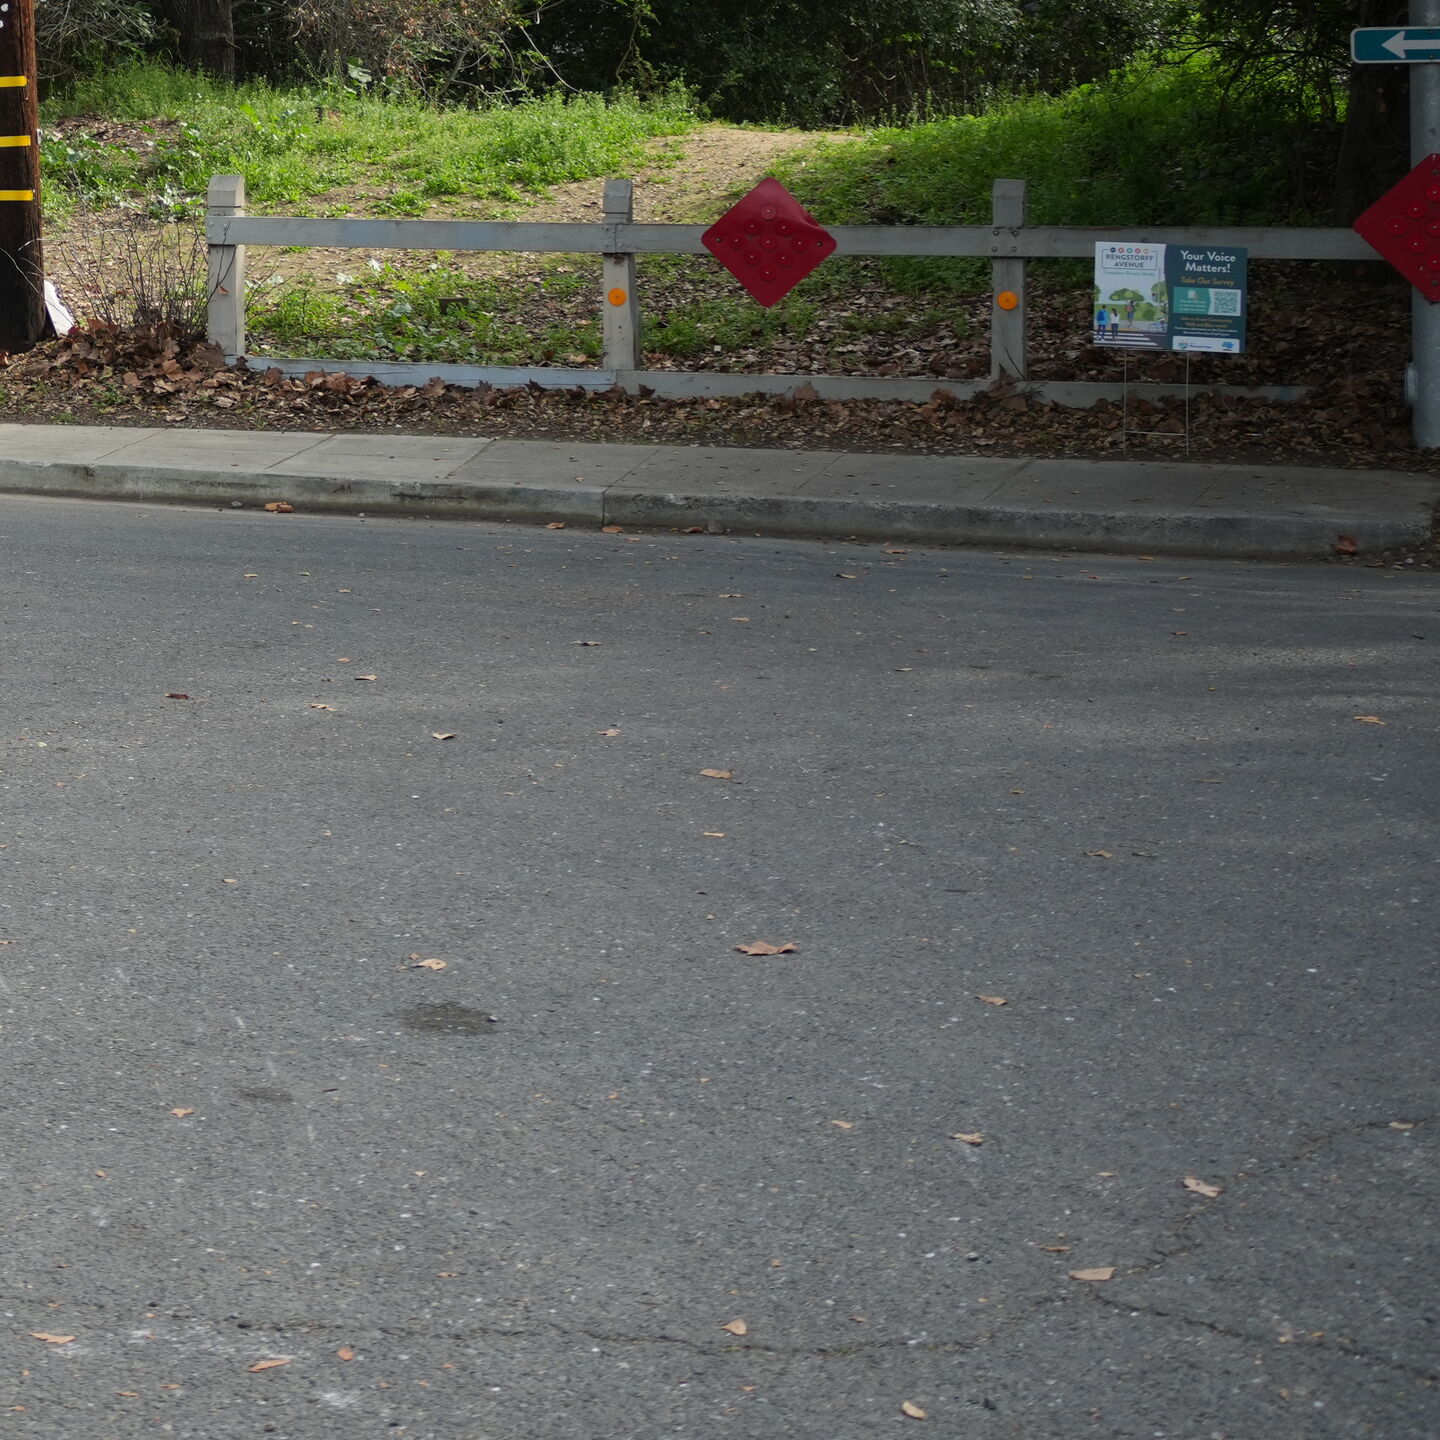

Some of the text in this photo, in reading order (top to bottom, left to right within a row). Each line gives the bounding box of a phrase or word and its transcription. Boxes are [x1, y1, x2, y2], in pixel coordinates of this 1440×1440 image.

[1180, 250, 1236, 262] Your Voice
[1185, 262, 1231, 273] Matters!
